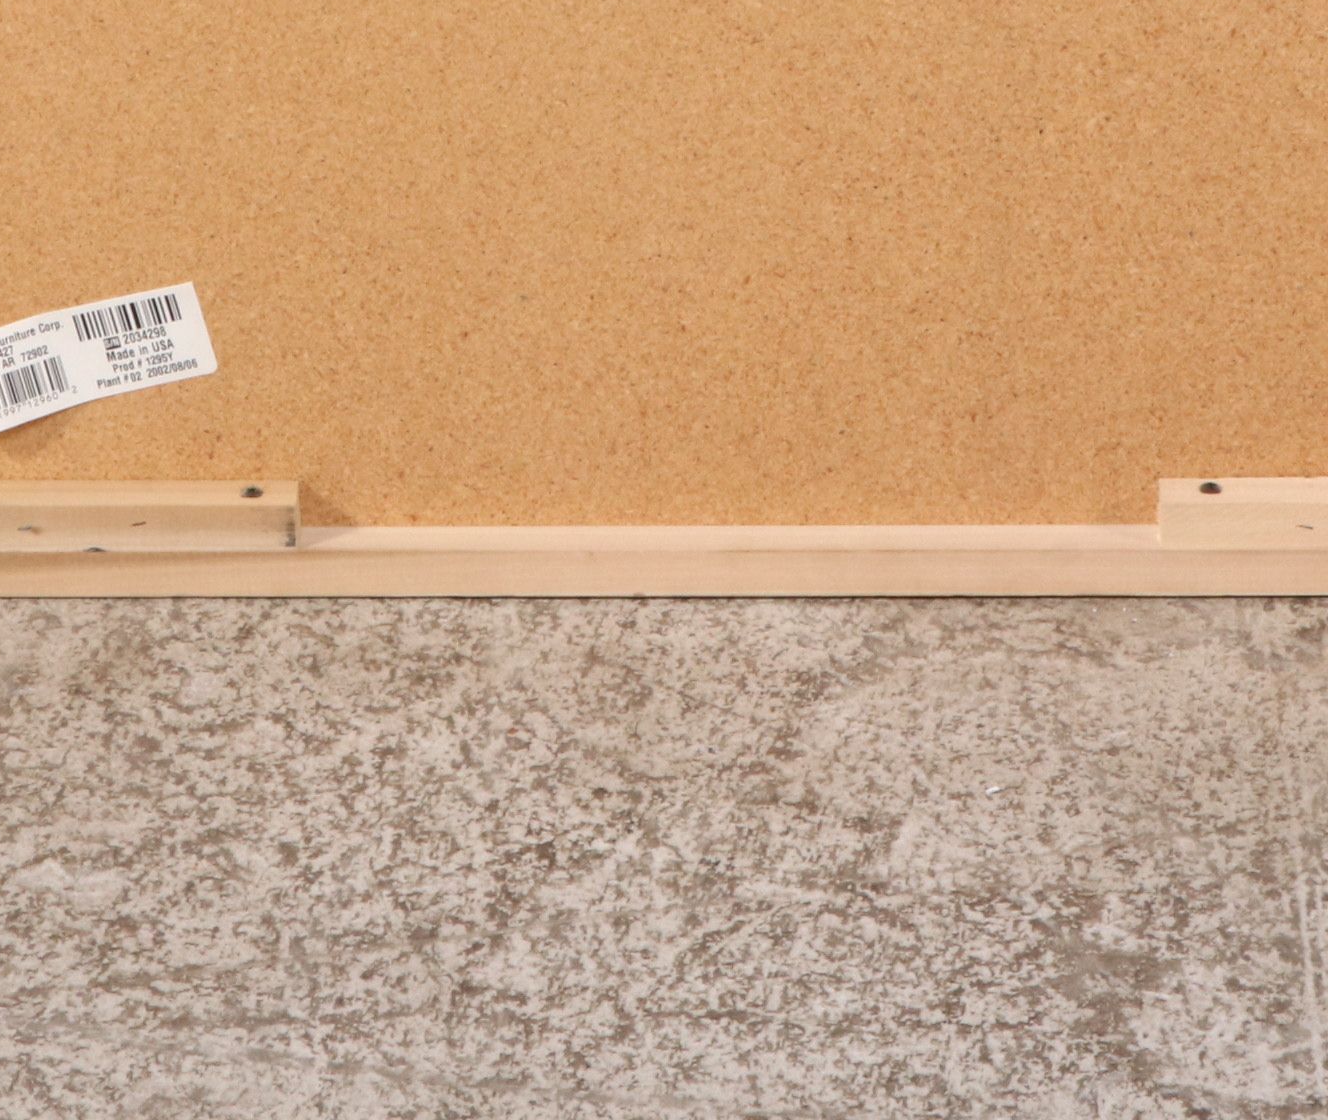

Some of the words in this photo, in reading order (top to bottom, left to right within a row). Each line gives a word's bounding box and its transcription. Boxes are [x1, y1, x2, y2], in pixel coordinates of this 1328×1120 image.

[38, 321, 64, 334] Corp.
[122, 326, 167, 345] 2034298
[2, 357, 16, 369] AR
[21, 345, 49, 362] 72902
[106, 347, 135, 362] Made
[138, 345, 148, 355] in
[152, 339, 174, 352] USA
[96, 376, 121, 389] Plant
[146, 358, 198, 378] 2002/08/06
[112, 361, 135, 373] Prod
[28, 392, 58, 408] 12960
[72, 385, 78, 394] 2
